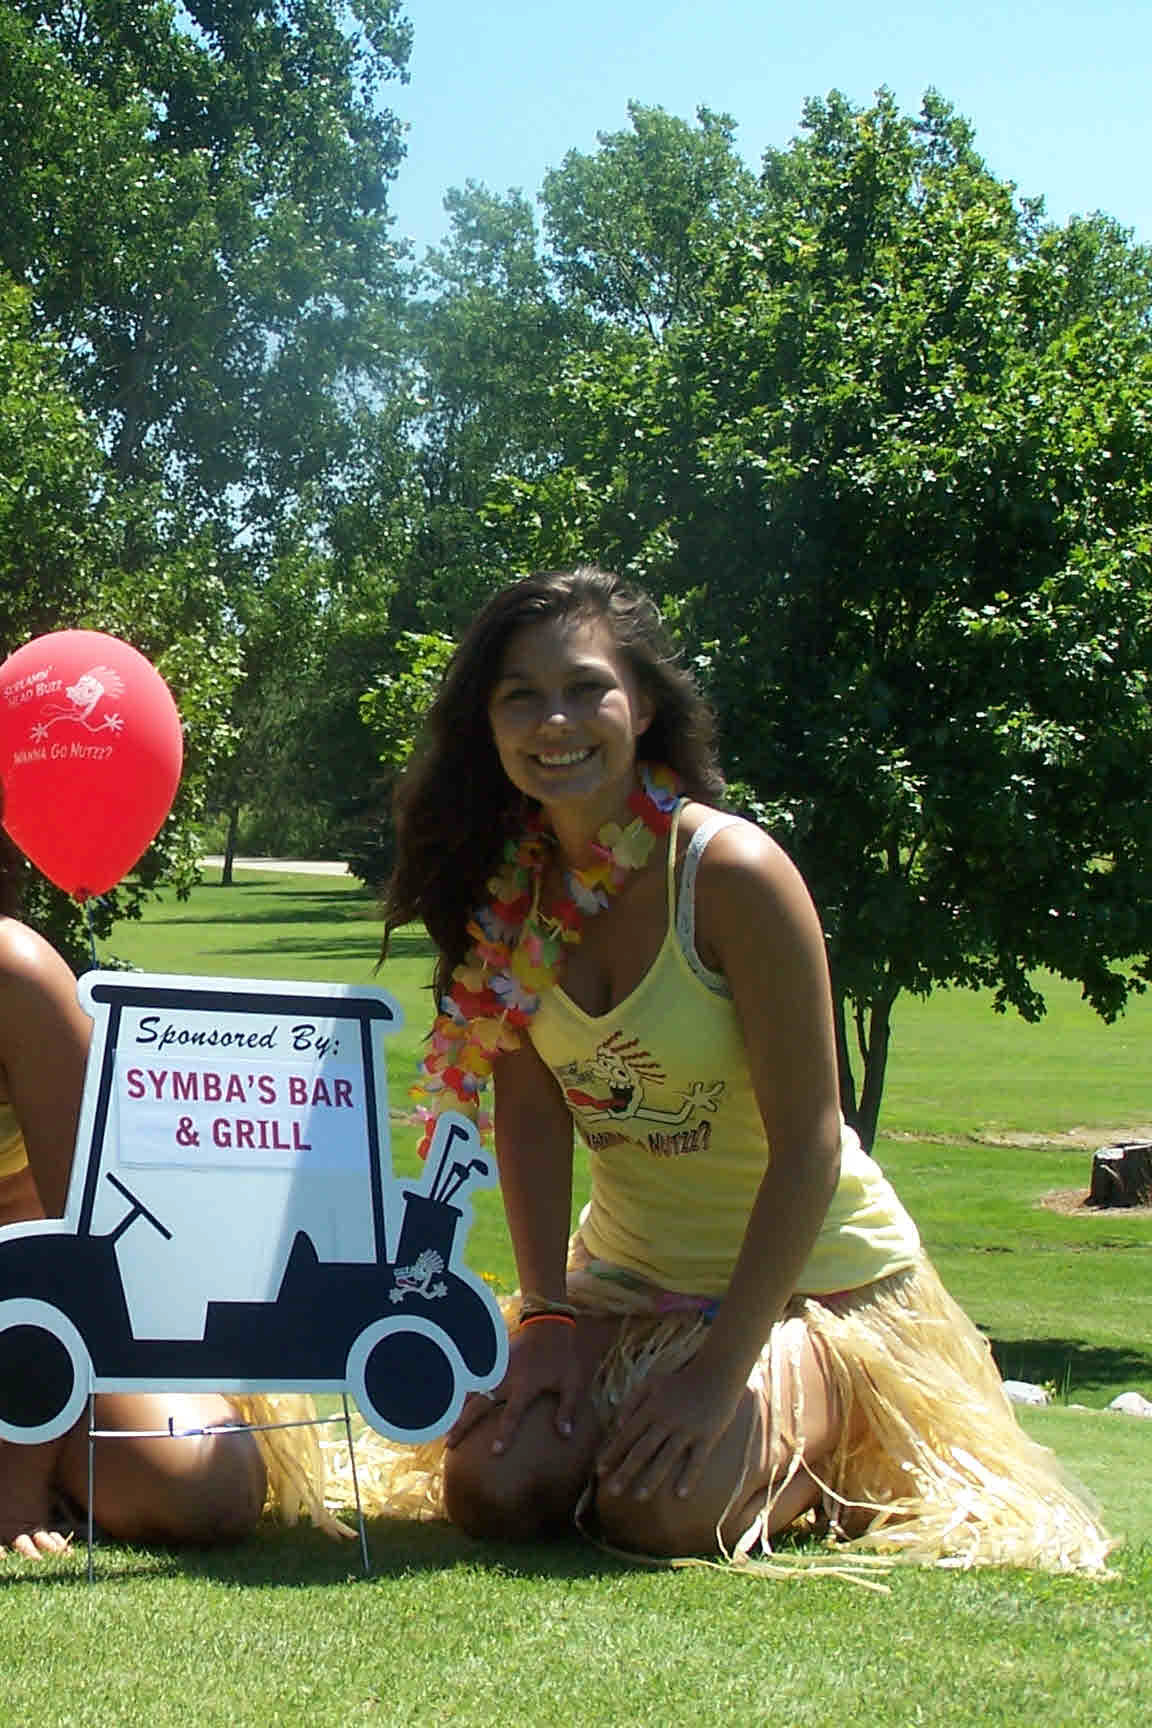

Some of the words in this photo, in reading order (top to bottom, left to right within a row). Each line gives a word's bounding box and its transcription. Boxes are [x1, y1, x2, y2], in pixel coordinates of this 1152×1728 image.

[50, 743, 68, 760] GO
[135, 1016, 279, 1051] Sponsored
[290, 1024, 341, 1059] By:
[126, 1068, 277, 1105] SYMBA'S
[288, 1076, 354, 1108] BAR
[175, 1116, 201, 1147] &
[212, 1118, 313, 1151] GRILL
